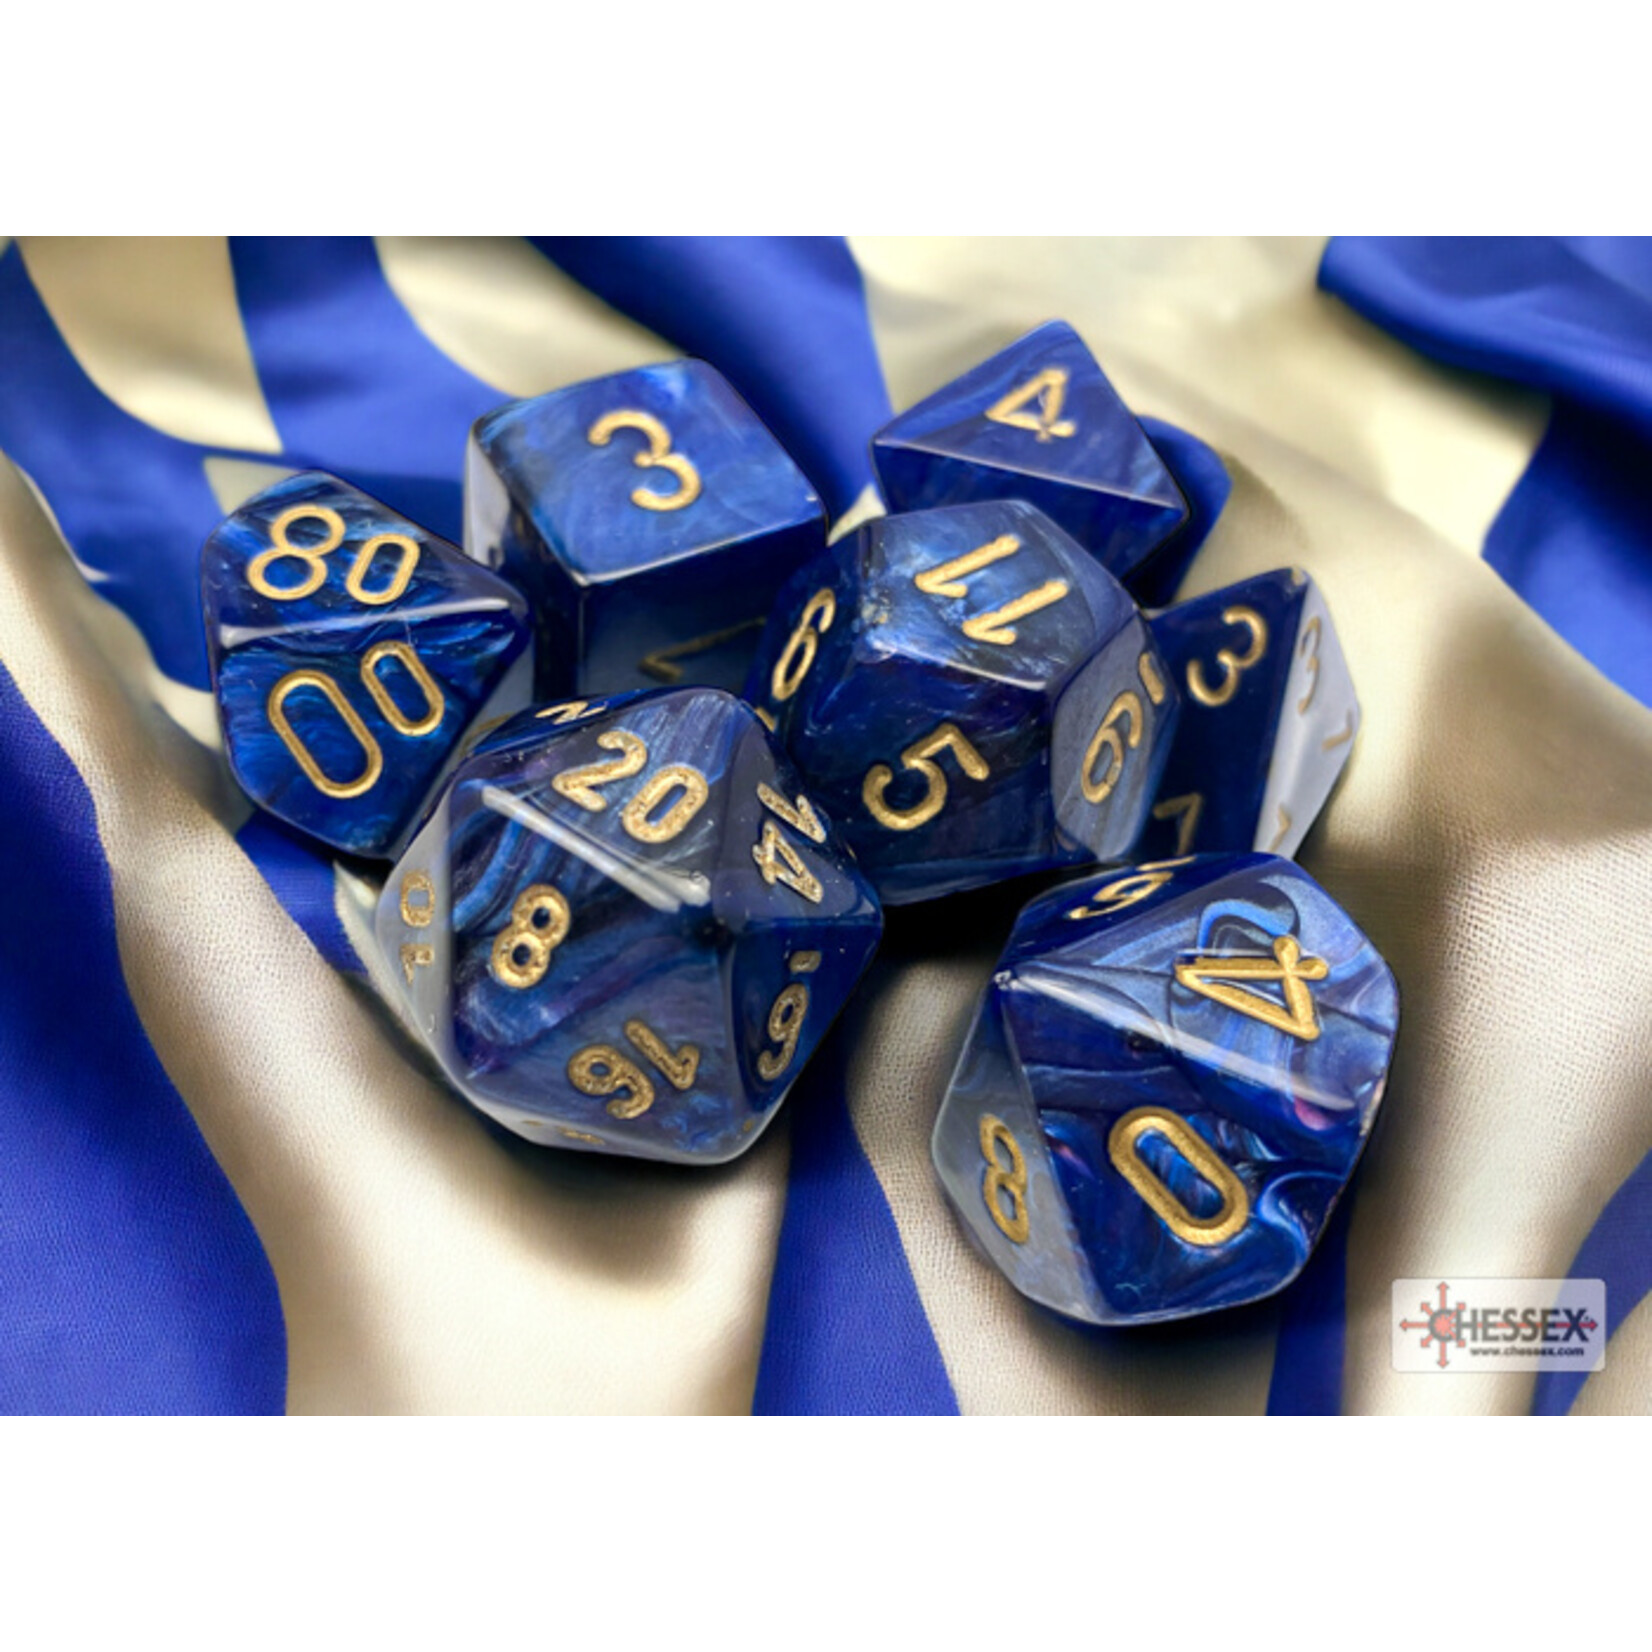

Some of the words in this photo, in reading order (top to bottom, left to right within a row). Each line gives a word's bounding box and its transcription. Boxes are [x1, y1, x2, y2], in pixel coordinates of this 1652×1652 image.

[985, 368, 1075, 440] 4
[588, 410, 703, 512] 3
[246, 504, 421, 604] 80
[915, 532, 1068, 646] 11
[1186, 605, 1268, 707] 3
[267, 640, 446, 799] 00
[552, 731, 709, 844] 20
[862, 724, 989, 831] 5
[752, 782, 826, 903] 14
[491, 884, 570, 989] 8
[1174, 935, 1329, 1042] 4
[567, 1021, 700, 1119] 16
[979, 1113, 1030, 1243] 8
[1108, 1106, 1249, 1247] 0
